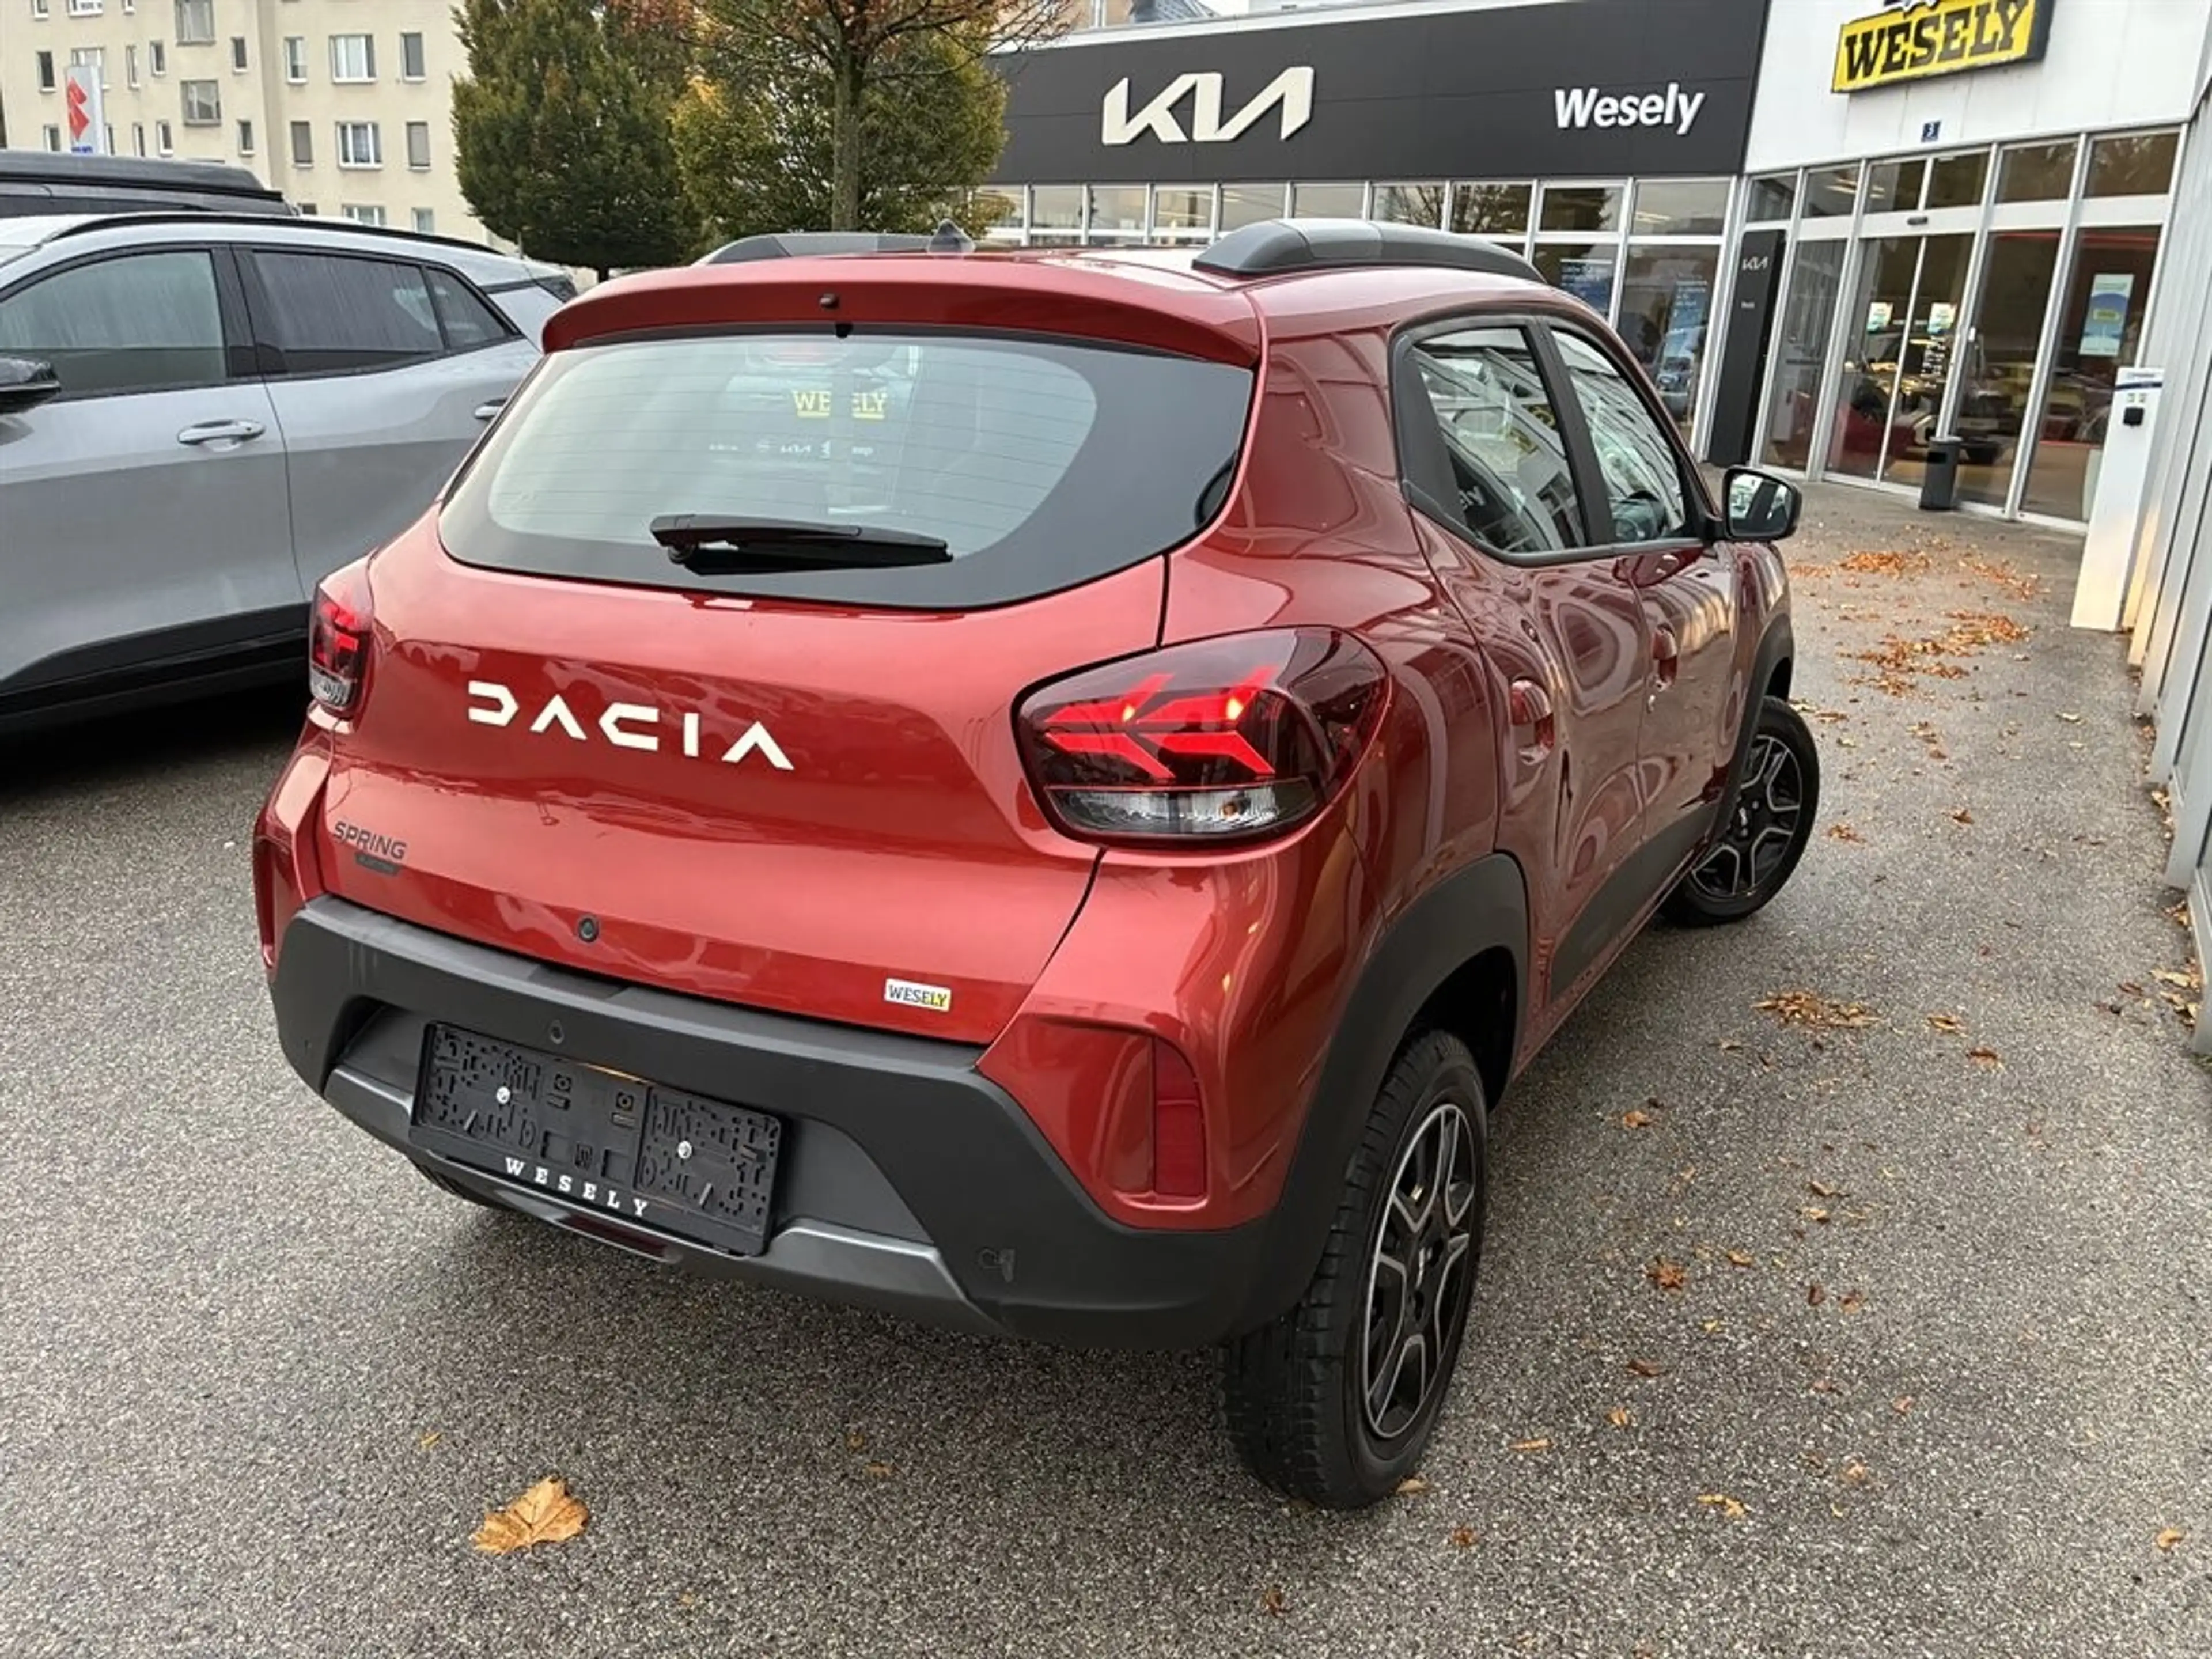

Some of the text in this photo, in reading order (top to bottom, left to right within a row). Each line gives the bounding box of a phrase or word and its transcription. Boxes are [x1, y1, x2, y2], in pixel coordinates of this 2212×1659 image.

[1844, 0, 2029, 81] WESELY
[1101, 66, 1315, 146] KIA
[1554, 82, 1706, 135] Wesely
[468, 679, 795, 771] DACIA
[332, 820, 408, 861] SPRING
[888, 984, 948, 1007] WESELY
[505, 1157, 648, 1217] WESELY
